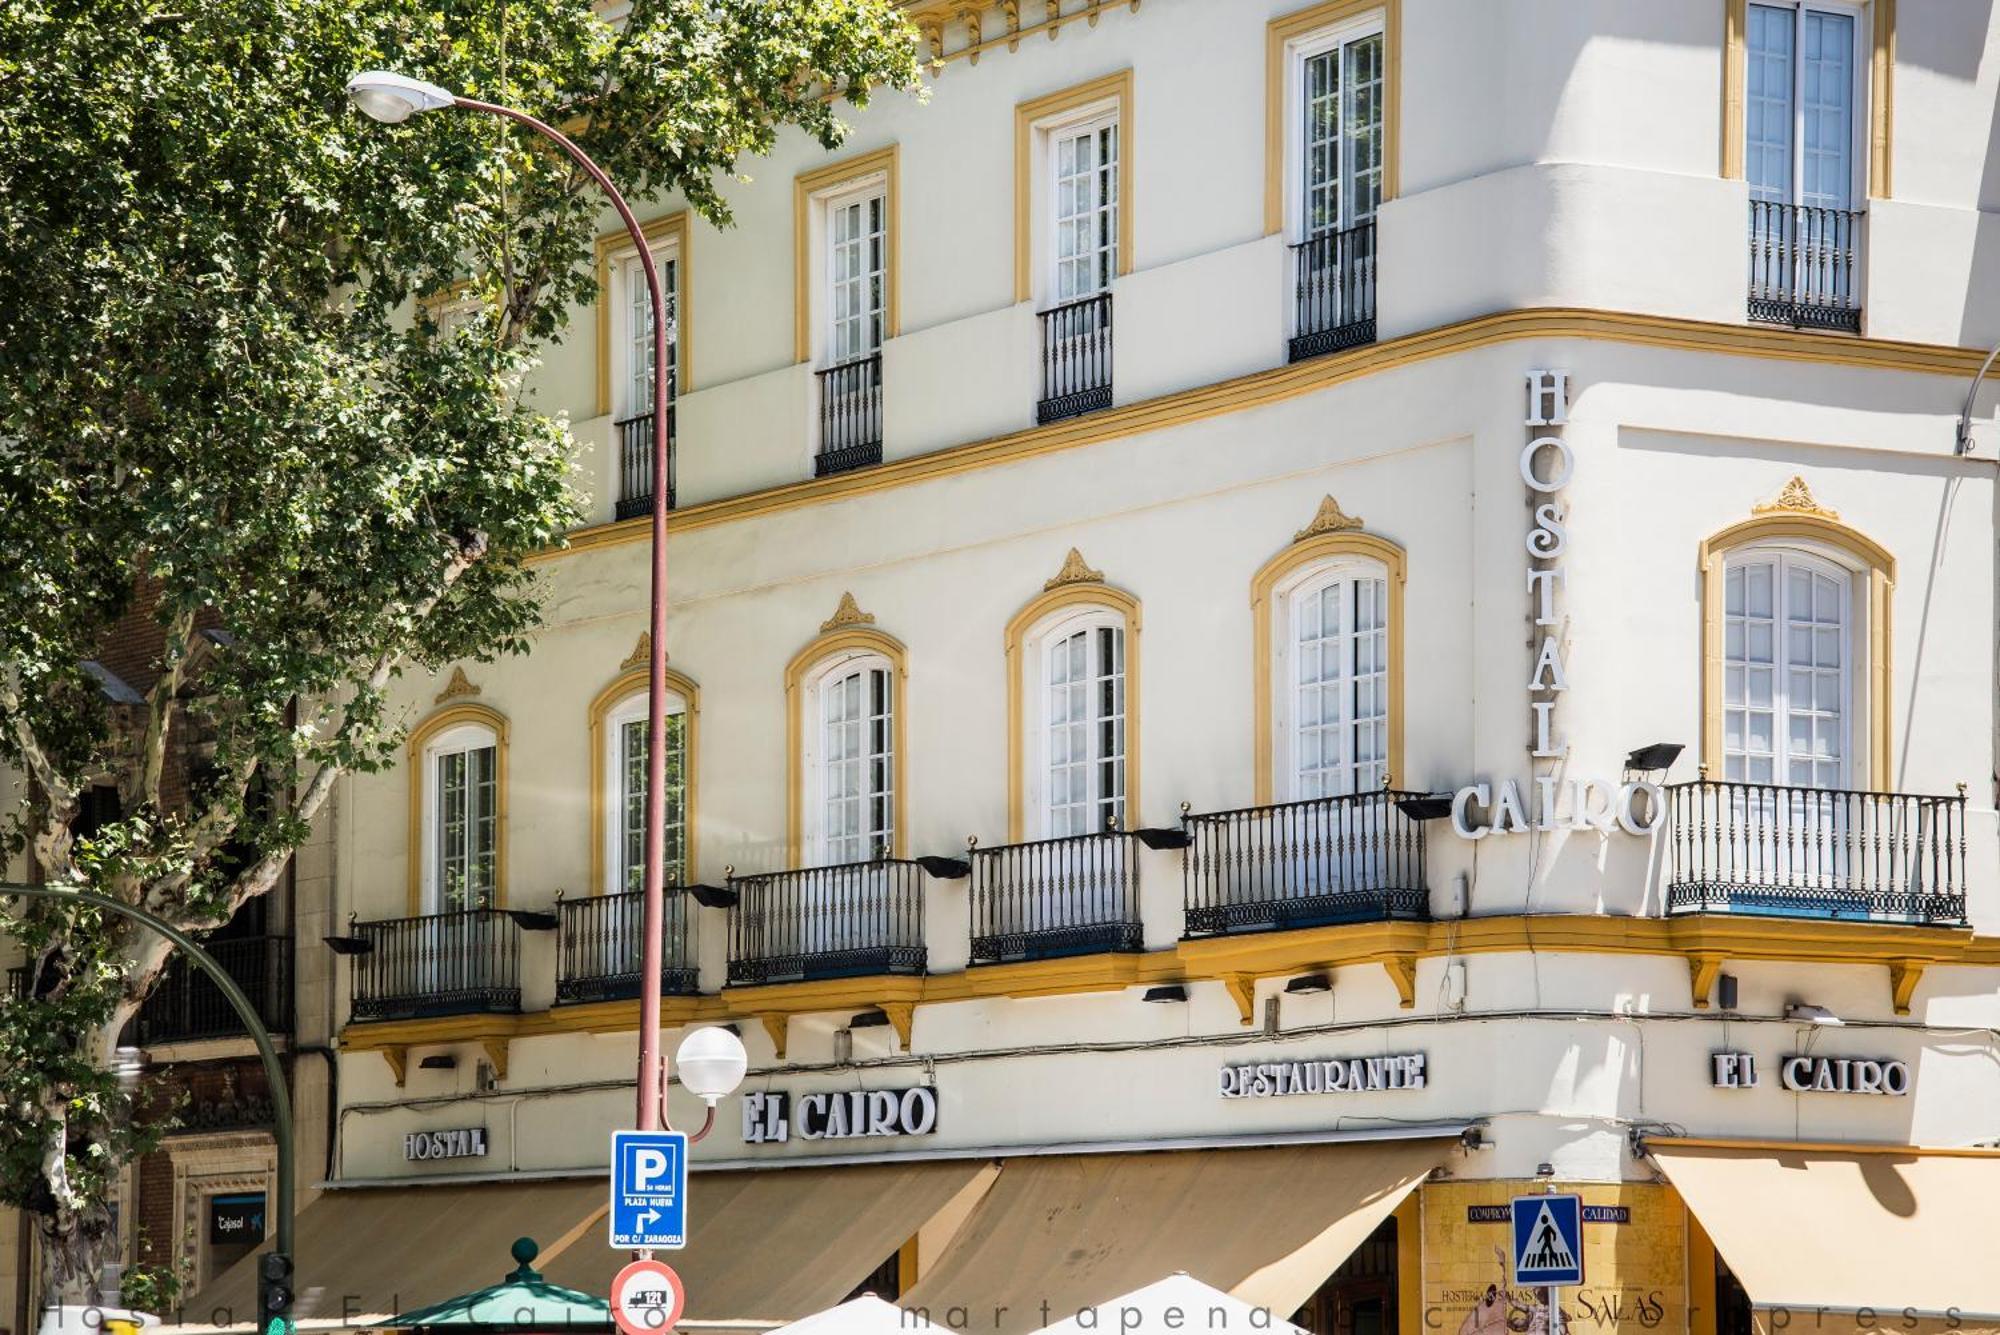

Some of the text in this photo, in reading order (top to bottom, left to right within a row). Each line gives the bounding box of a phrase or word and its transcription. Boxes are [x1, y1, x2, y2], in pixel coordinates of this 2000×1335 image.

[1519, 369, 1574, 757] HOSTAL
[1451, 777, 1666, 839] CAIRO
[1218, 1053, 1425, 1099] RESTAURANTE
[1713, 1052, 1912, 1096] EL CAIRO
[742, 1087, 936, 1143] EL CAIRO
[403, 1128, 486, 1160] HOSTAL
[635, 1149, 667, 1191] P
[624, 1197, 673, 1207] PLAZA NUEVA
[1583, 1206, 1628, 1222] CALIDAD
[219, 1215, 244, 1232] Cajasol
[614, 1234, 630, 1244] POR
[644, 1234, 682, 1244] ZARAGOZA
[645, 1291, 662, 1305] 12t
[1577, 1288, 1665, 1322] SALAS
